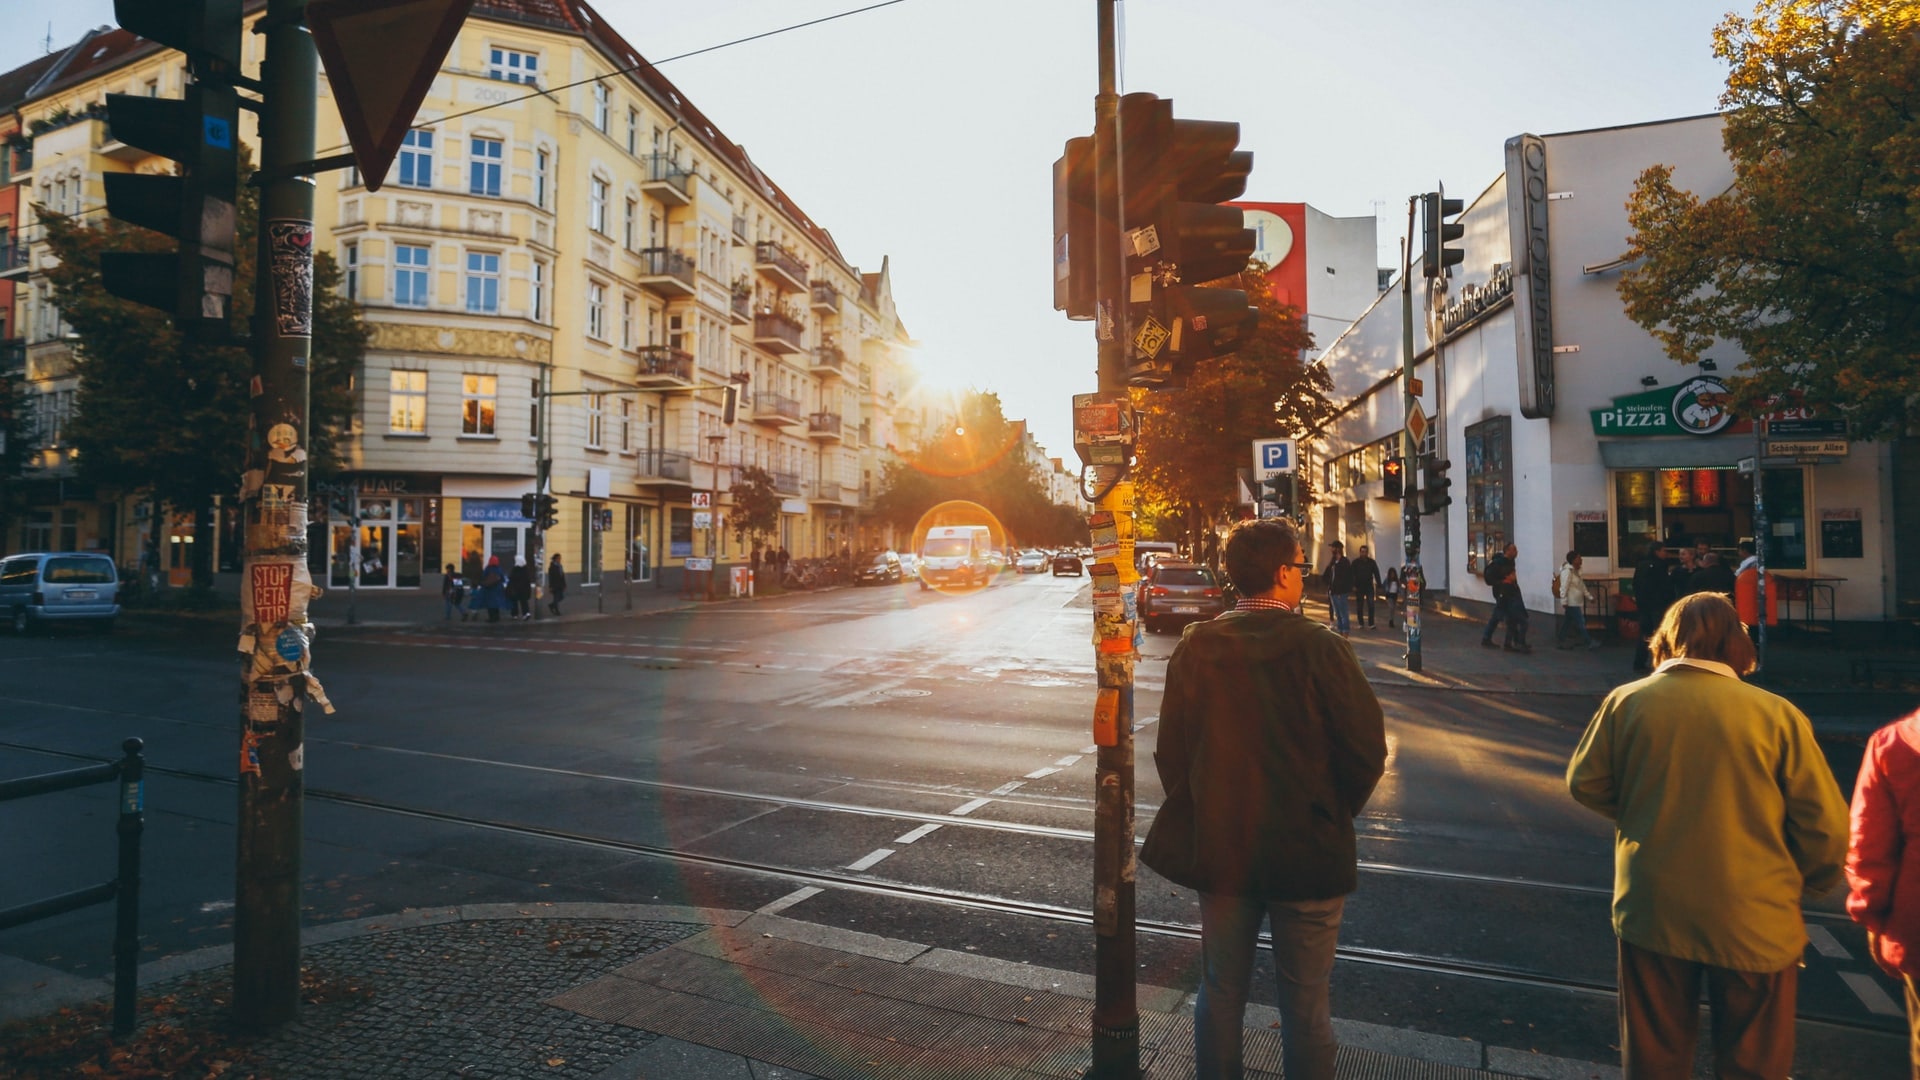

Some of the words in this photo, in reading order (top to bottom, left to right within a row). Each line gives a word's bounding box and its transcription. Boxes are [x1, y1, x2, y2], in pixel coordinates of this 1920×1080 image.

[1524, 142, 1554, 406] COLOSSEUM
[1600, 408, 1667, 428] Pizza
[1268, 447, 1282, 466] P
[1771, 443, 1820, 453] Schönhauser
[1823, 443, 1844, 452] Allee
[363, 477, 409, 494] HAIR
[254, 566, 290, 587] STOP
[254, 586, 287, 606] CETA
[256, 606, 286, 624] TTIP
